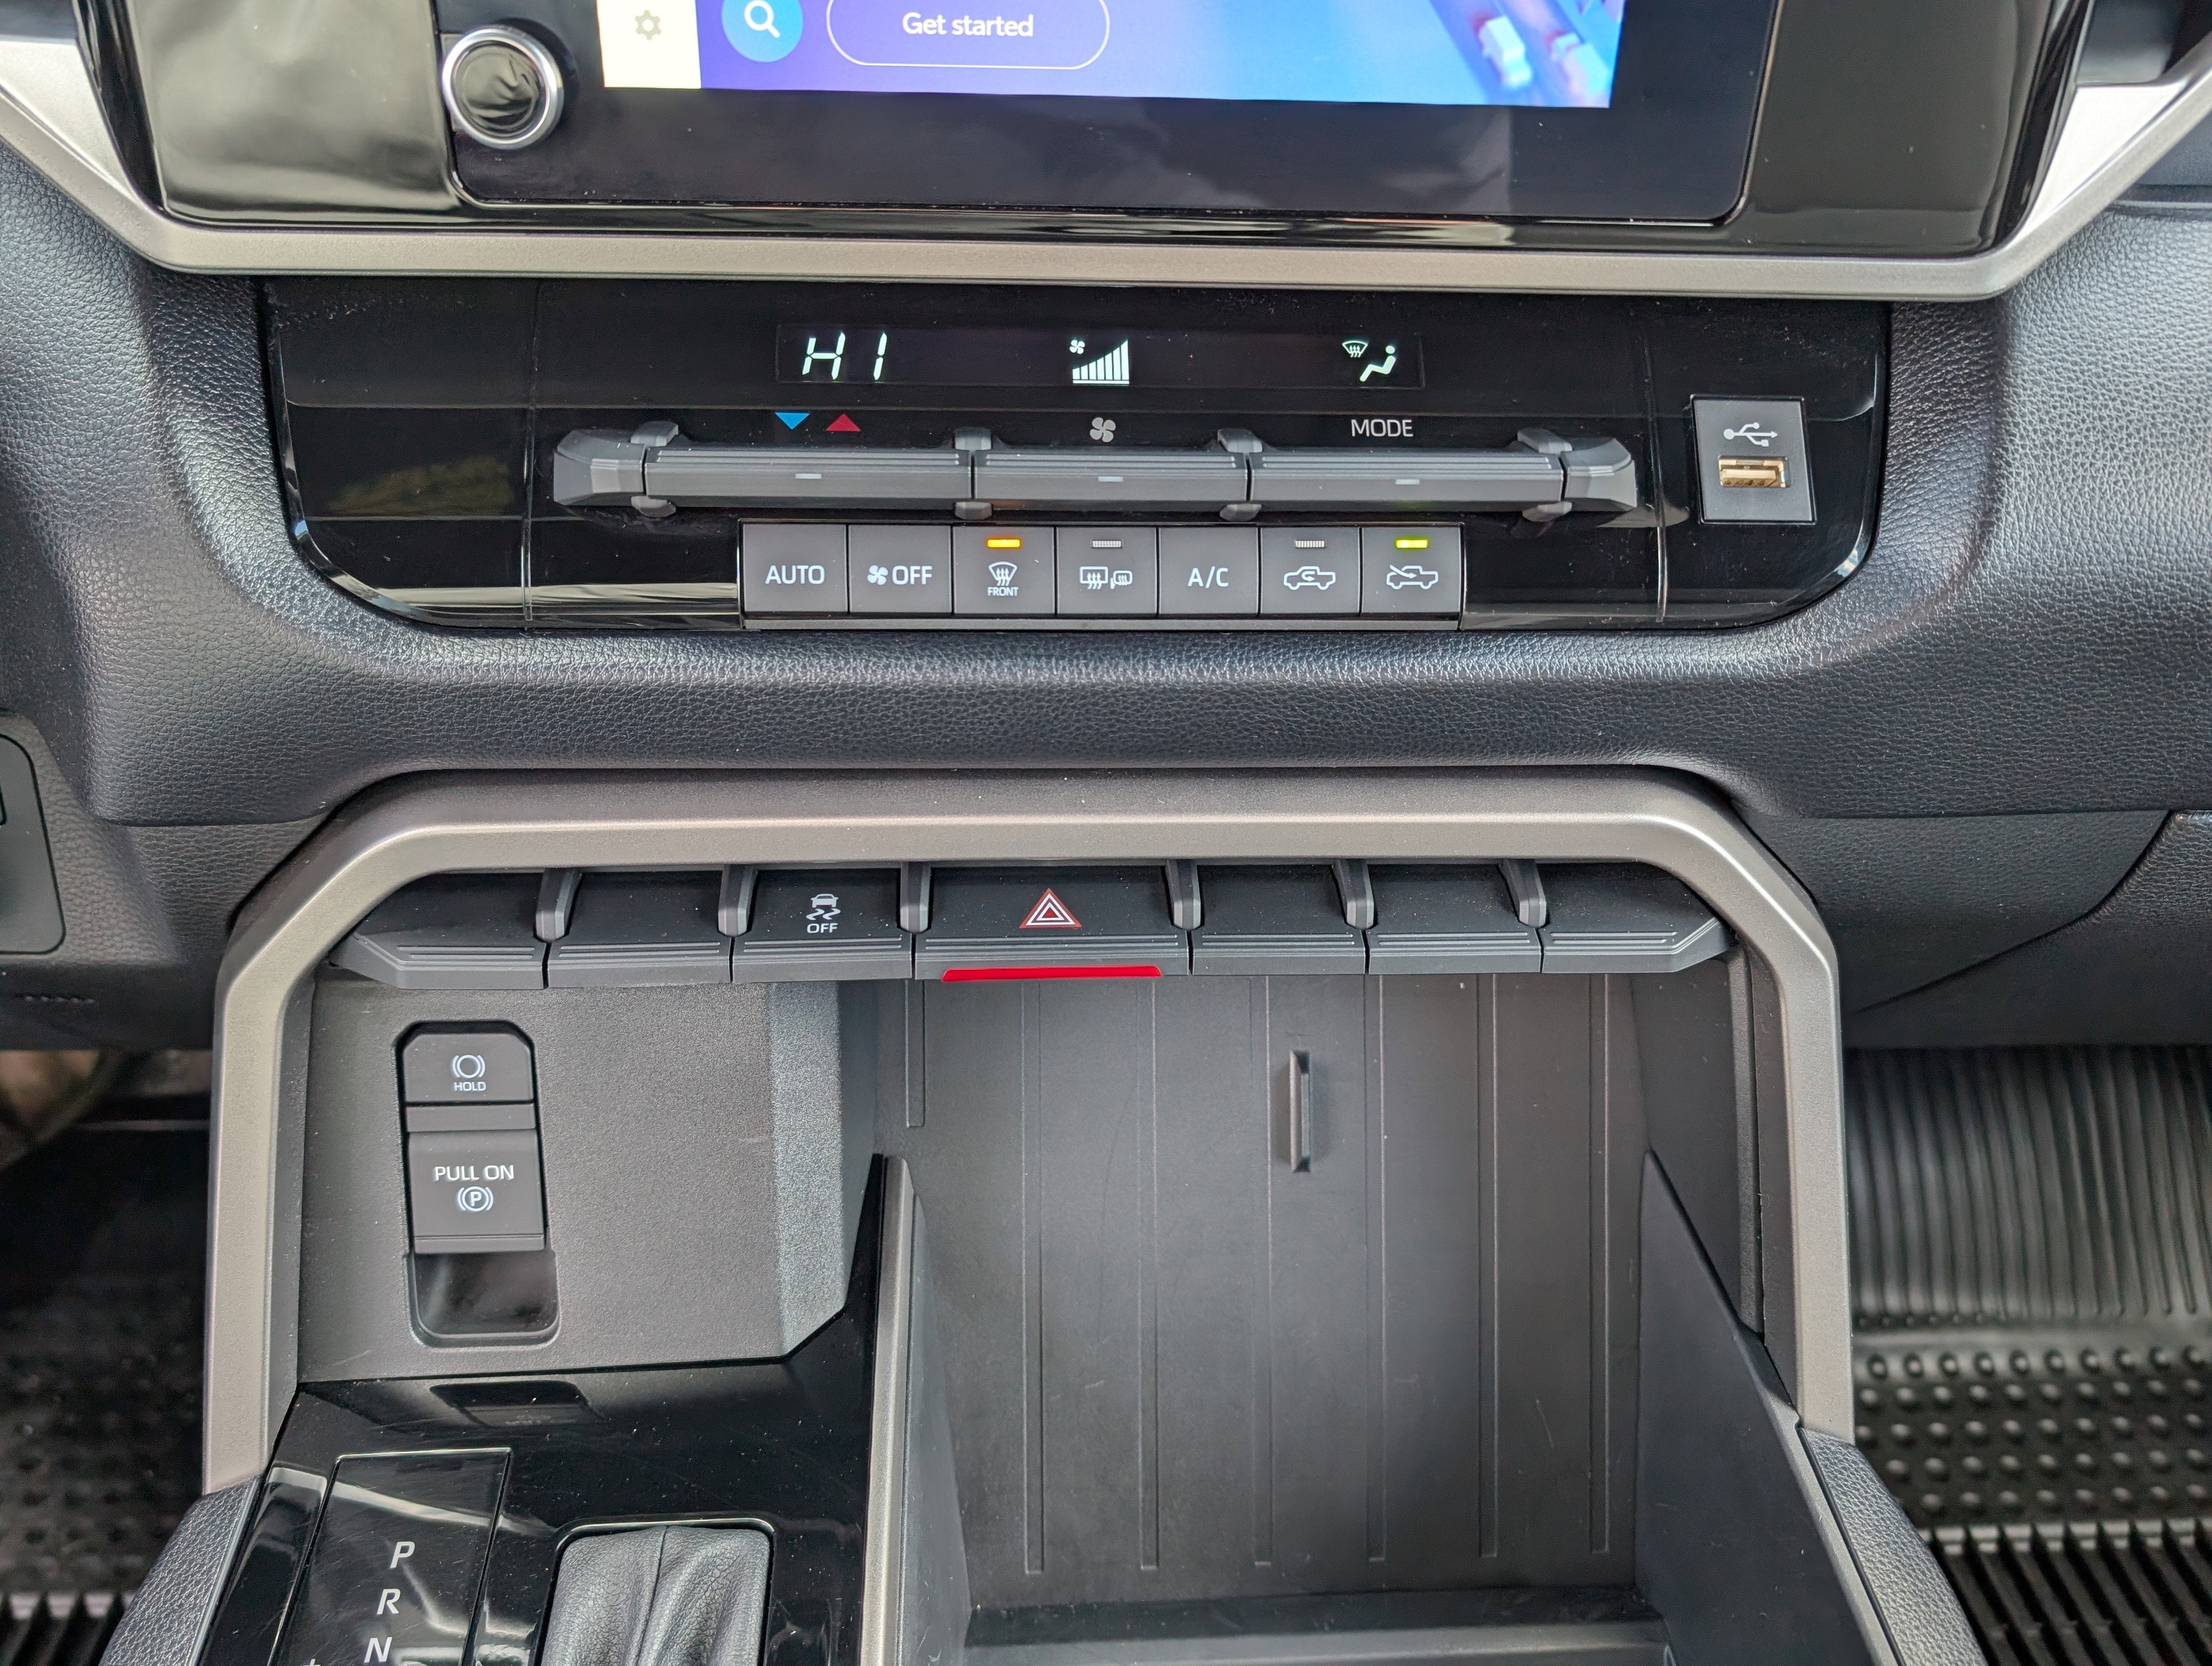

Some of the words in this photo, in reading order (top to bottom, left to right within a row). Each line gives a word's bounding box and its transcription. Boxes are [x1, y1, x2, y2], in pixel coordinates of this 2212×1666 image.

[902, 12, 947, 35] Get
[951, 14, 1034, 37] started
[1351, 418, 1413, 437] MODE
[765, 565, 825, 585] AUTO
[892, 565, 933, 585] OFF
[1187, 565, 1229, 588] A/C
[987, 586, 1019, 597] FRONT
[807, 922, 838, 934] OFF
[454, 1081, 486, 1092] HOLD
[434, 1165, 480, 1181] PULL
[484, 1164, 515, 1181] ON
[390, 1541, 415, 1569] P
[376, 1588, 401, 1615] R
[364, 1637, 393, 1663] N
